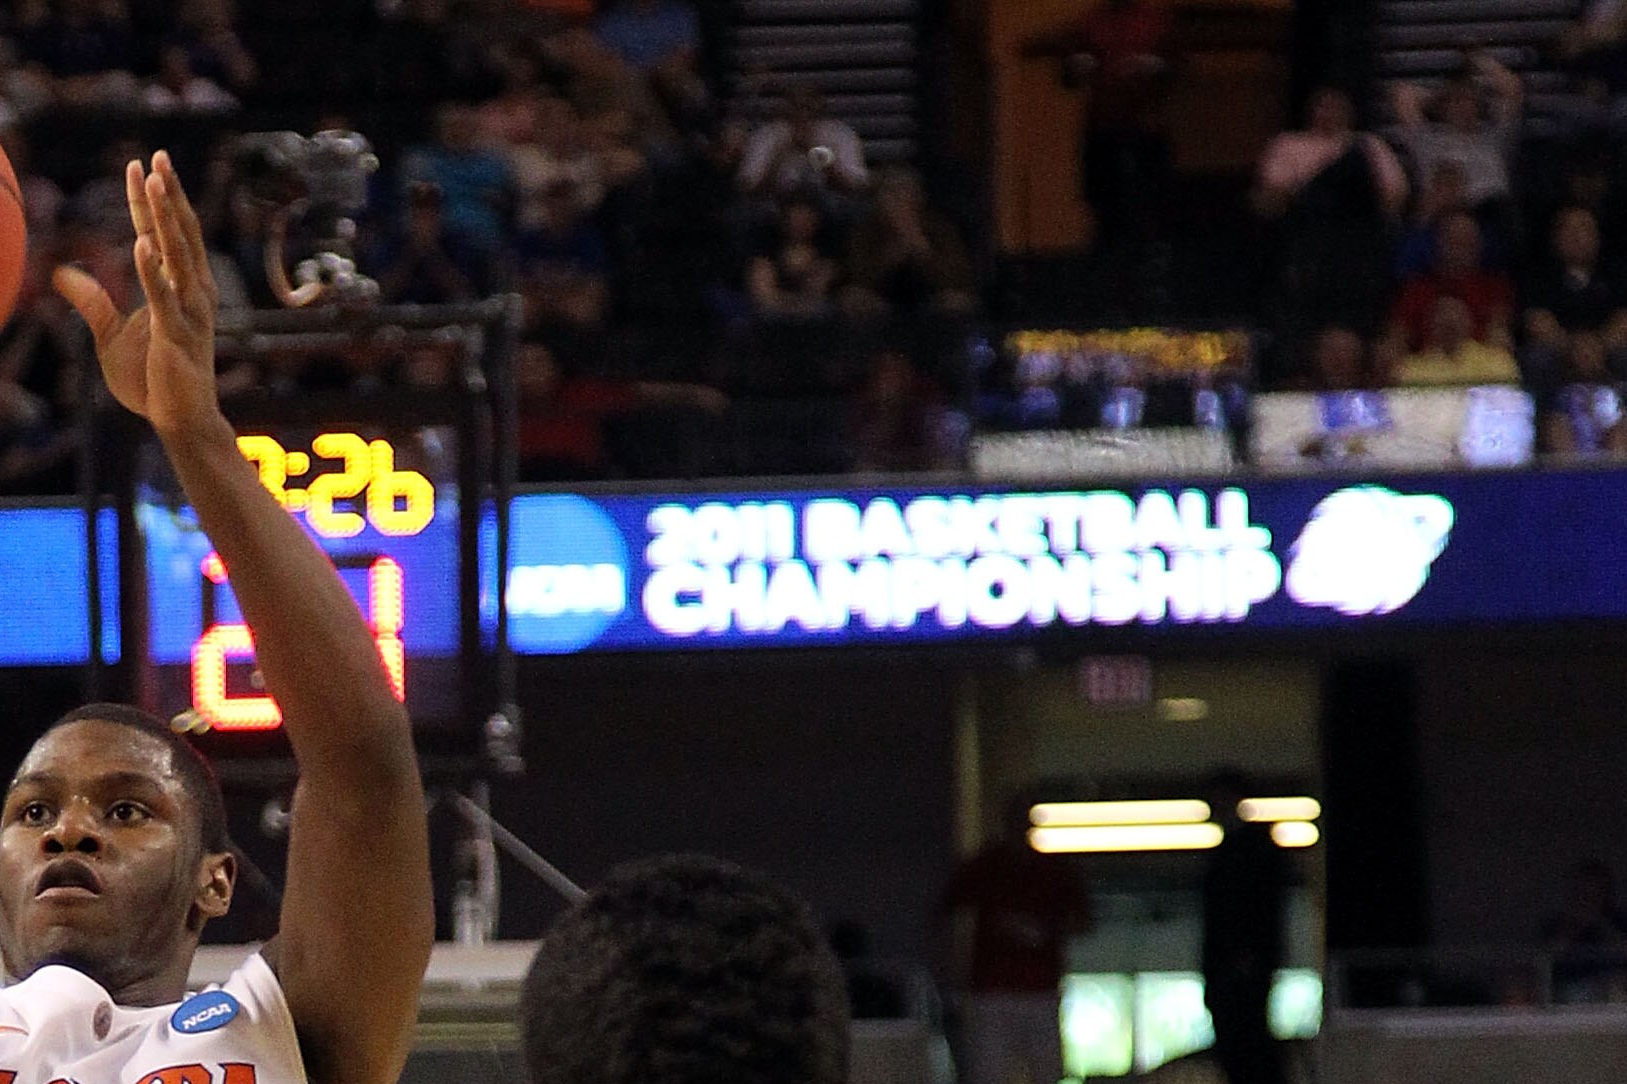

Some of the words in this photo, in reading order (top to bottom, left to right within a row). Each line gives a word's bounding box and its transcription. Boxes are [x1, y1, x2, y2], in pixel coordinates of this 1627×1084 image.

[644, 501, 796, 564] 2011
[801, 486, 1273, 564] BASKETBALL
[640, 546, 1283, 638] CHAMPIONSHIP
[181, 1002, 233, 1031] NCAA
